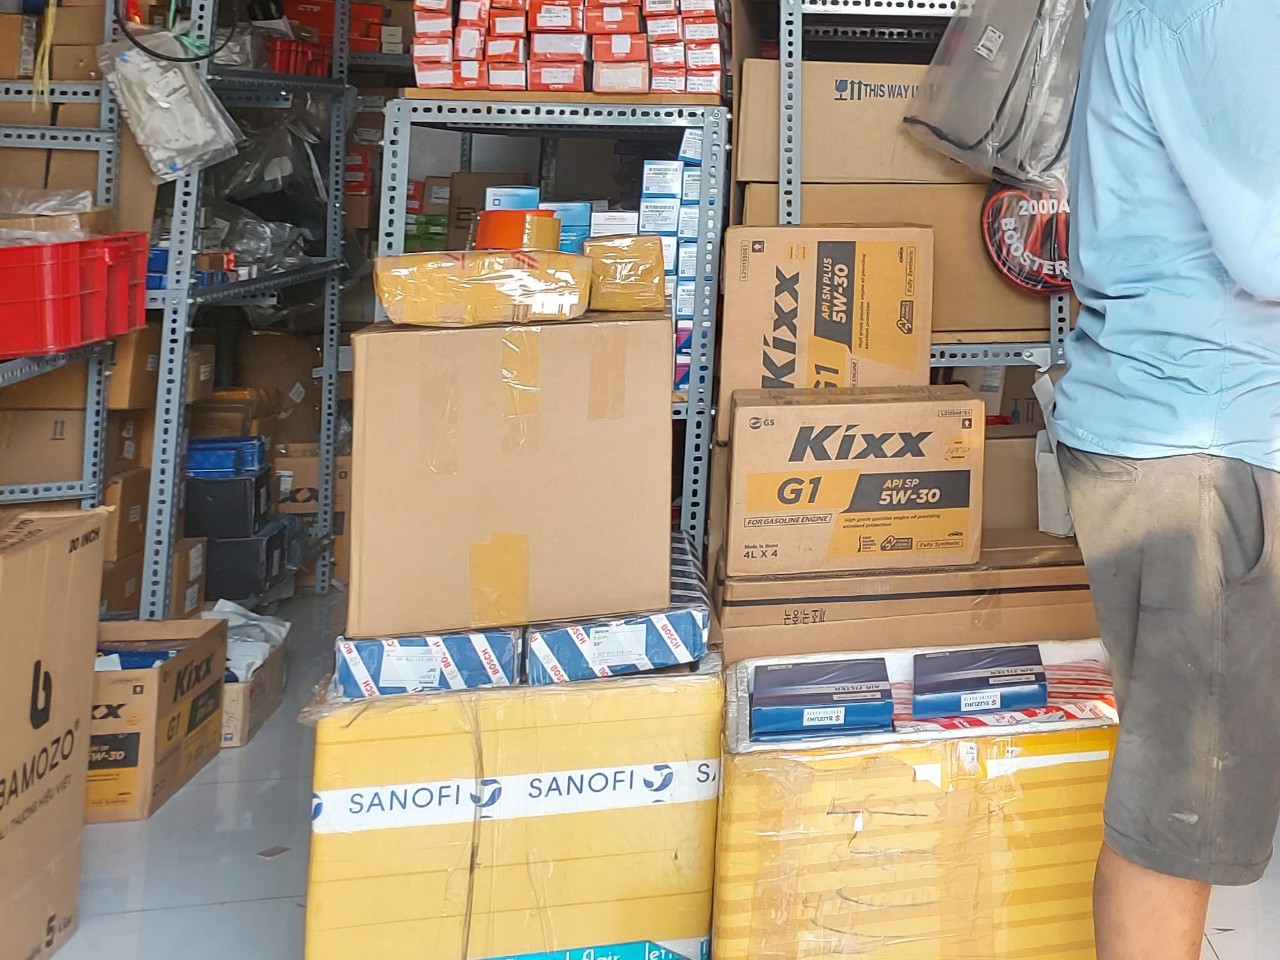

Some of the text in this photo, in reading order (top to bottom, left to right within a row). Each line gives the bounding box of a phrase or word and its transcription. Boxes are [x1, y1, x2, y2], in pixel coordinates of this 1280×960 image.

[863, 84, 885, 98] THIS
[887, 85, 910, 98] WAY
[1019, 199, 1070, 216] 2000A
[1001, 218, 1070, 276] BOOSTER
[821, 257, 833, 320] API SN PLUS
[832, 263, 849, 324] 5W-30
[761, 265, 800, 388] Kixx
[763, 418, 775, 427] GS
[788, 423, 933, 462] Kixx
[776, 476, 823, 505] G1
[883, 479, 919, 488] API SP
[879, 489, 941, 506] 5W-30
[747, 515, 829, 526] FOR GASOLINE ENGINE
[743, 549, 778, 559] 4L X 4
[660, 623, 681, 650] BOSCH
[480, 648, 500, 676] BOSCH
[964, 700, 991, 708] SUZUKI
[806, 715, 833, 723] SUZUKI
[528, 770, 634, 799] SANOFI
[348, 784, 461, 814] SANOFI
